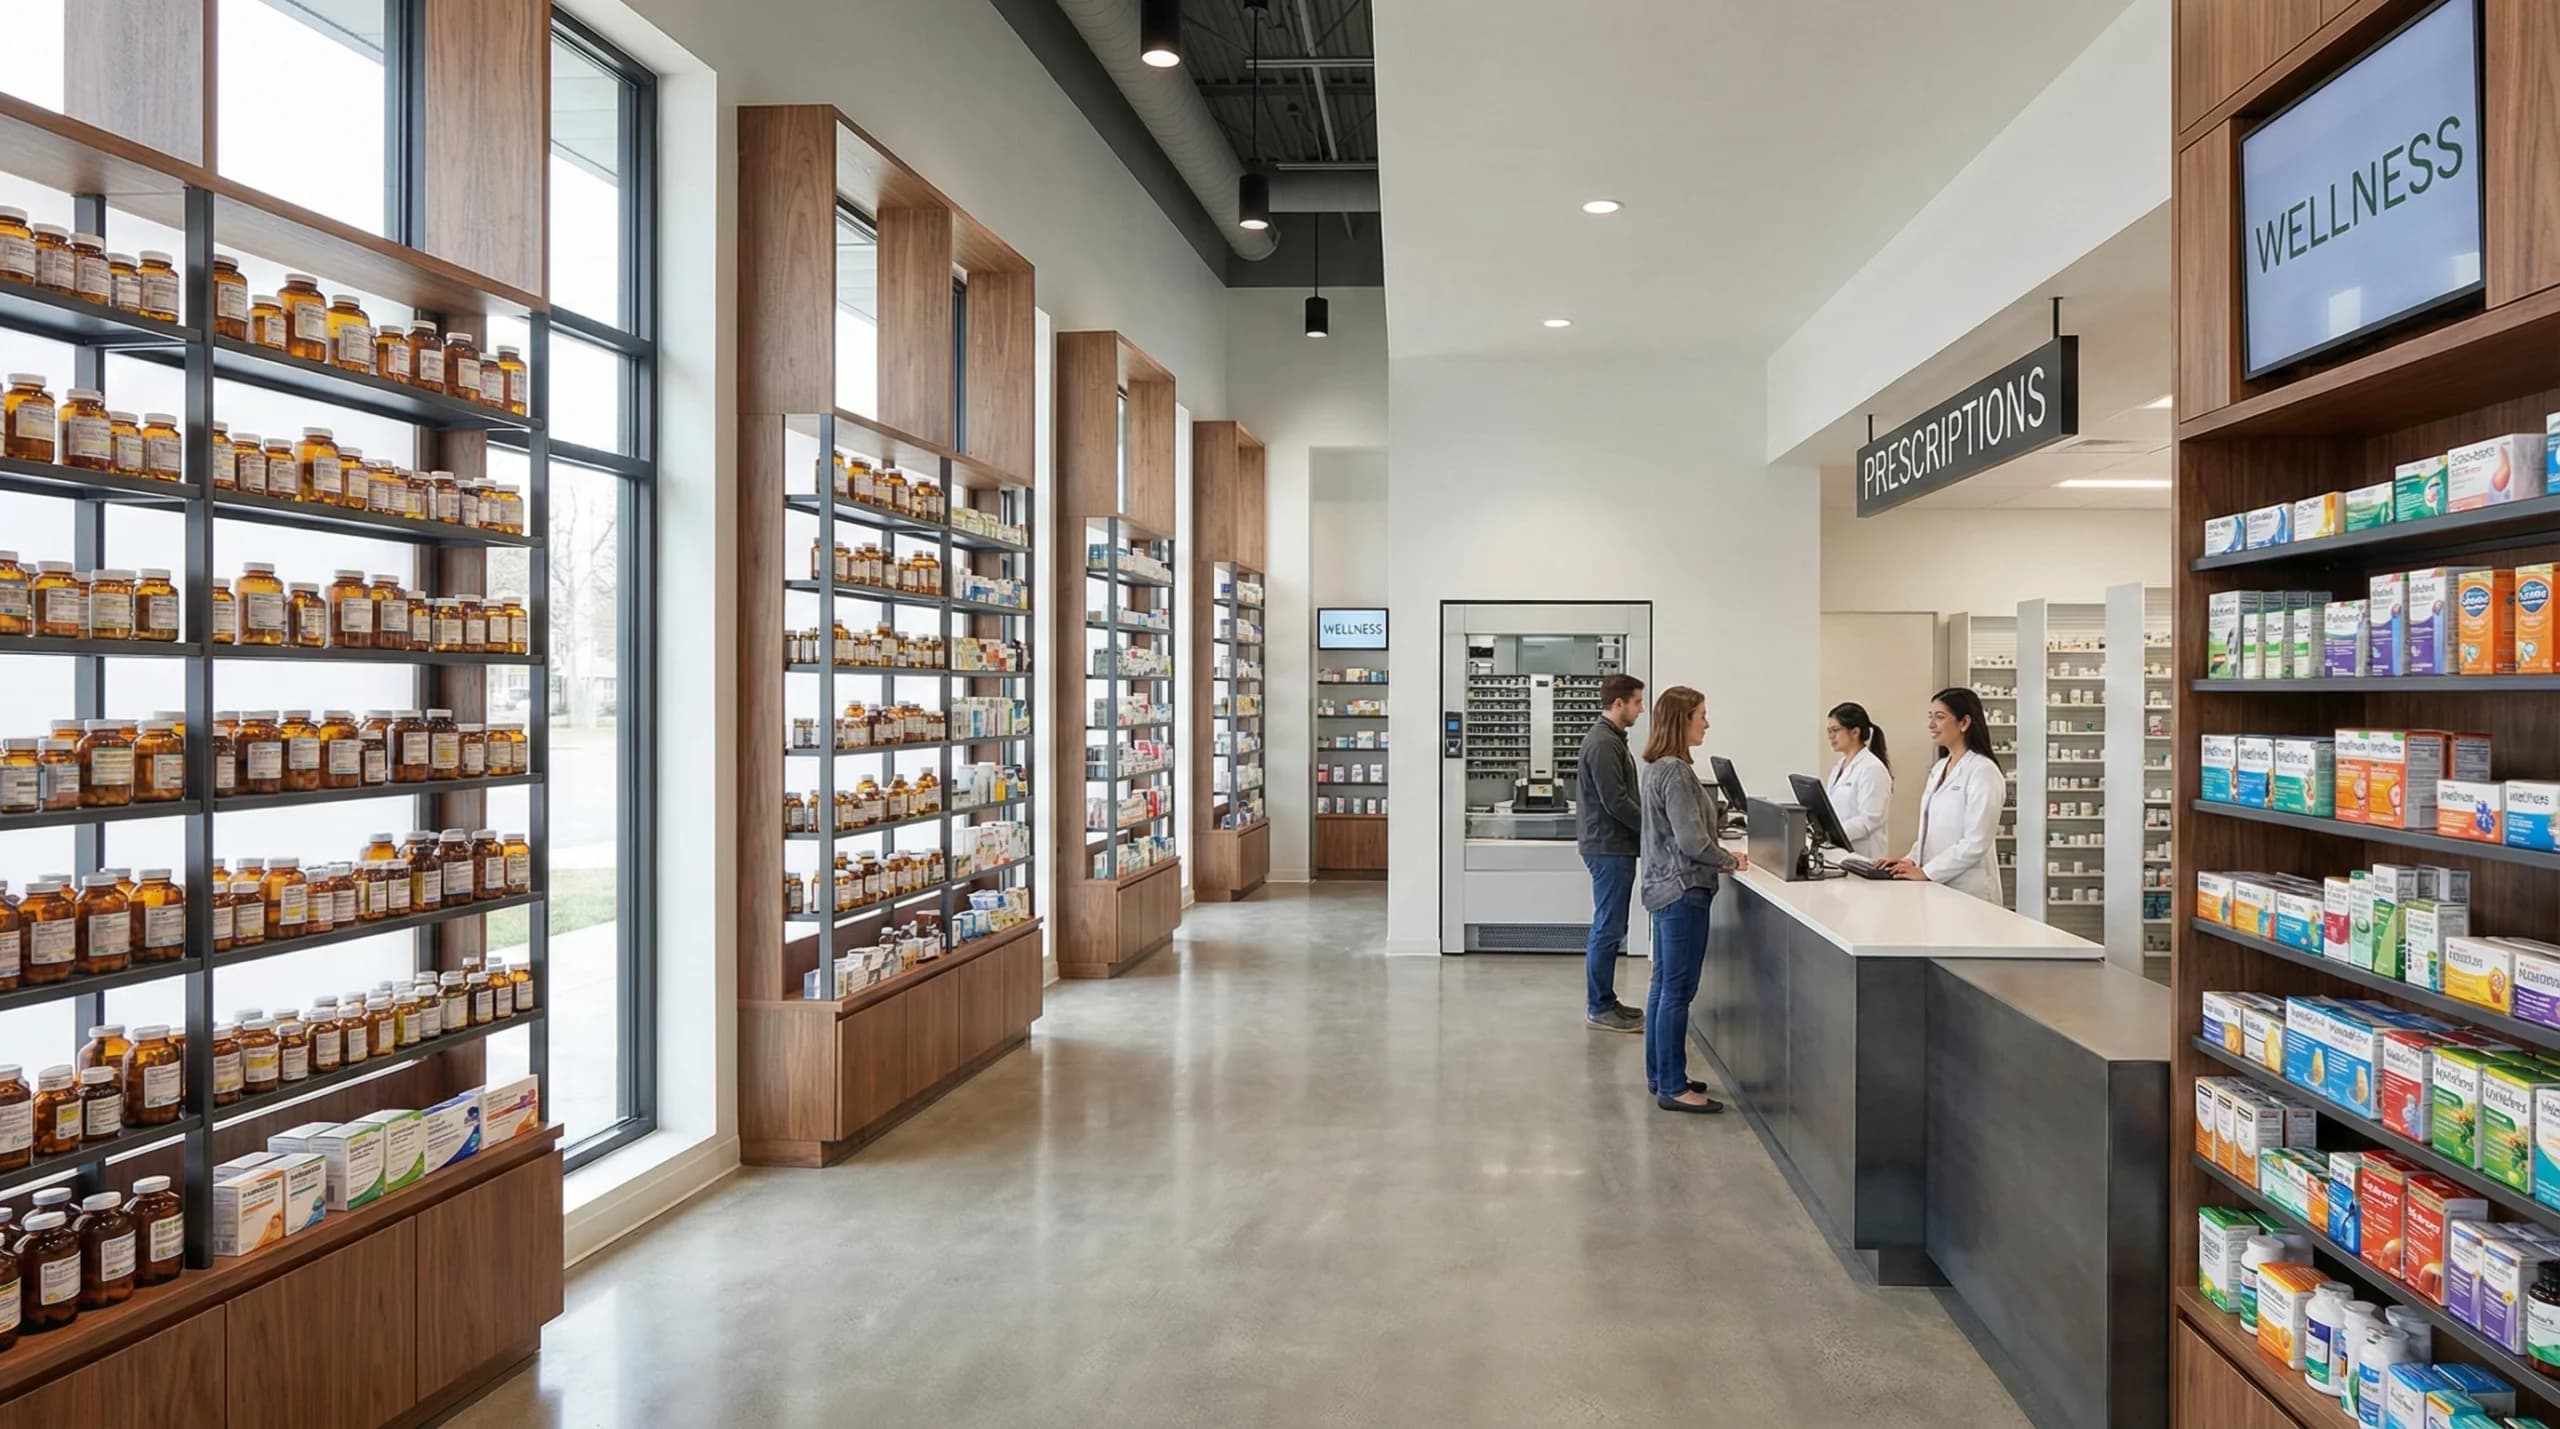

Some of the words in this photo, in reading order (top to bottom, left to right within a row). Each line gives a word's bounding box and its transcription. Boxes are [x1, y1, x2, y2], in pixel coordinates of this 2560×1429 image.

[2256, 116, 2463, 273] WELLNESS
[1864, 366, 2046, 501] PRESCRIPTIONS
[1323, 623, 1383, 635] WELLNESS
